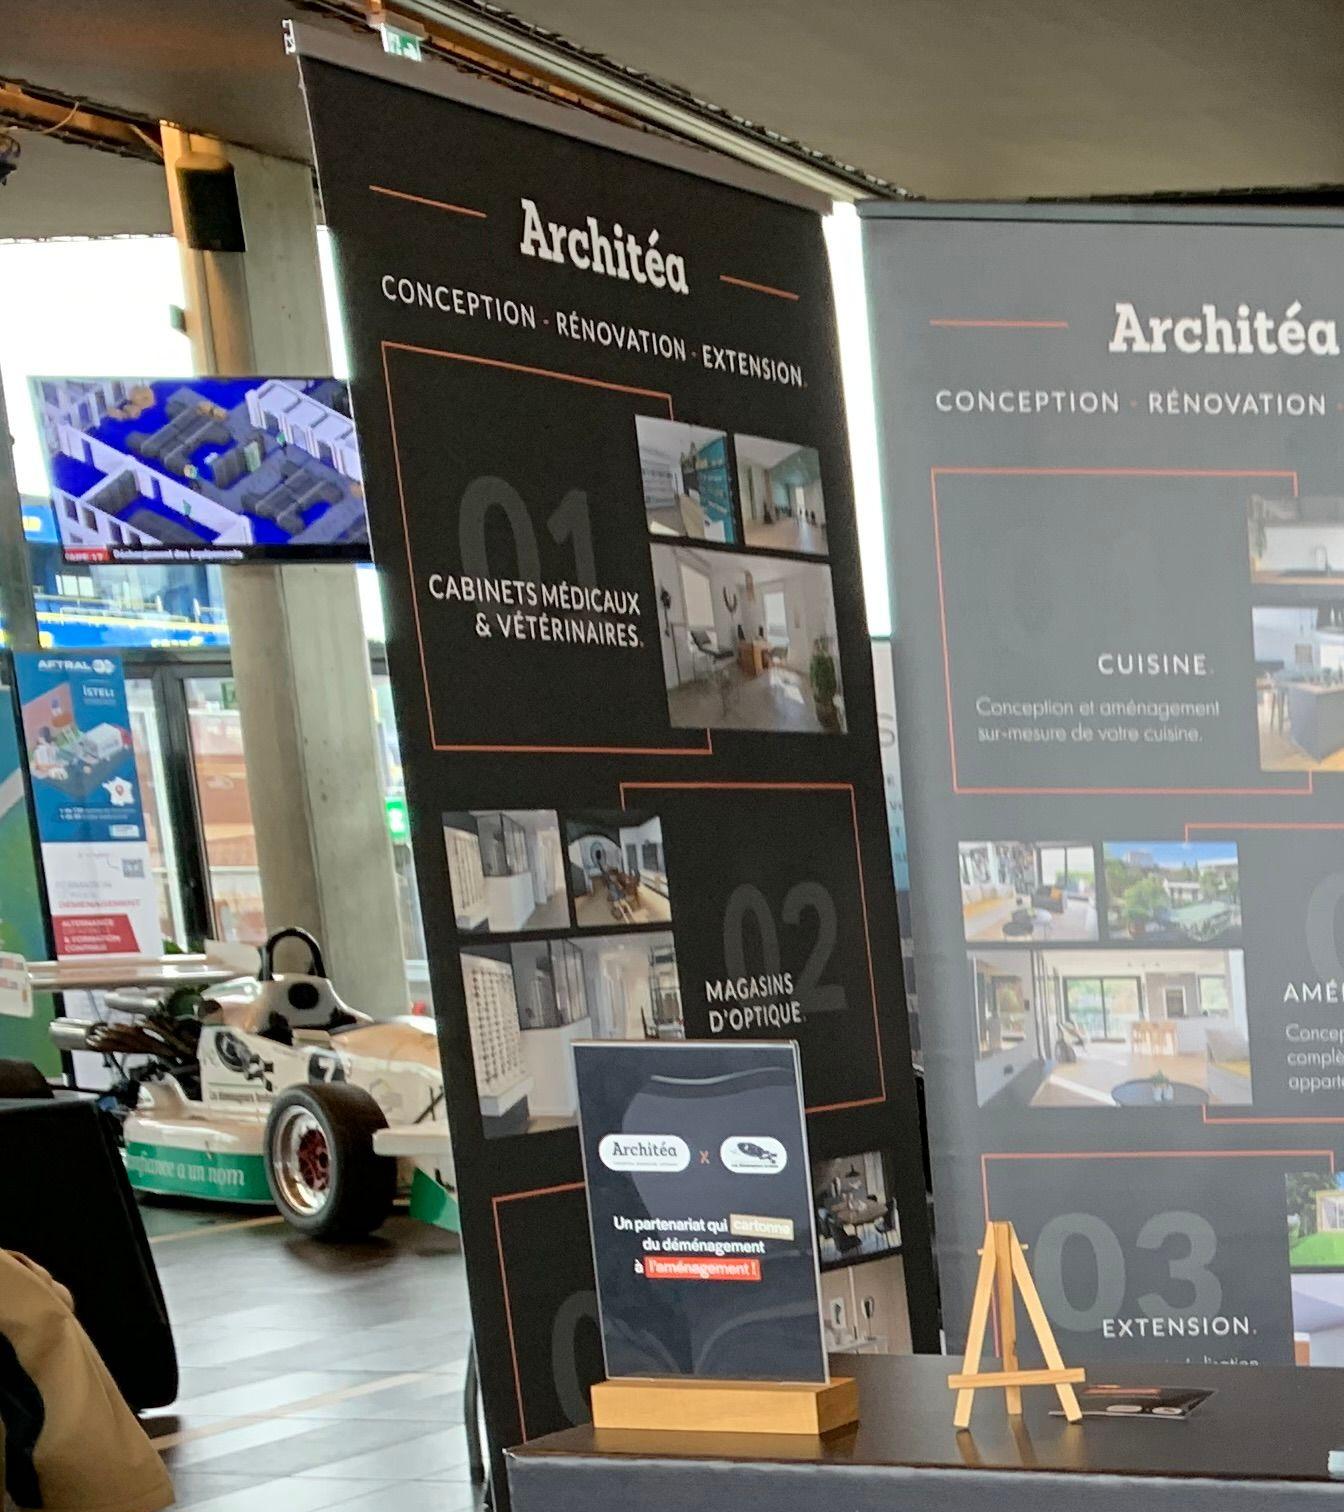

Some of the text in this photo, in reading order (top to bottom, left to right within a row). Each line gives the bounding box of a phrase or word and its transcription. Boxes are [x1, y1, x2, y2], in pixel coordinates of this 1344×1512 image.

[520, 198, 689, 295] Architéa
[381, 274, 537, 330] CONCEPTION
[556, 311, 687, 363] RÉNOVATION
[1109, 301, 1340, 355] Architéa
[936, 390, 1120, 414] CONCEPTION
[1149, 387, 1327, 417] RÉNOVATION
[429, 573, 640, 615] CABINETS MÉDICAUX
[476, 612, 492, 638] &
[976, 697, 1220, 721] Conception et aménagement
[977, 722, 1203, 742] sur-mesure de votre cuisine.
[705, 971, 794, 1003] MAGASINS
[319, 1057, 336, 1083] 7
[612, 1140, 678, 1157] Architéa
[613, 1216, 791, 1235] Un partenariat qui cartonne
[642, 1237, 766, 1256] du déménagement
[634, 1259, 644, 1274] à
[650, 1258, 749, 1278] l'aménagement
[1033, 1210, 1224, 1334] 03
[1102, 1316, 1258, 1339] EXTENSION.
